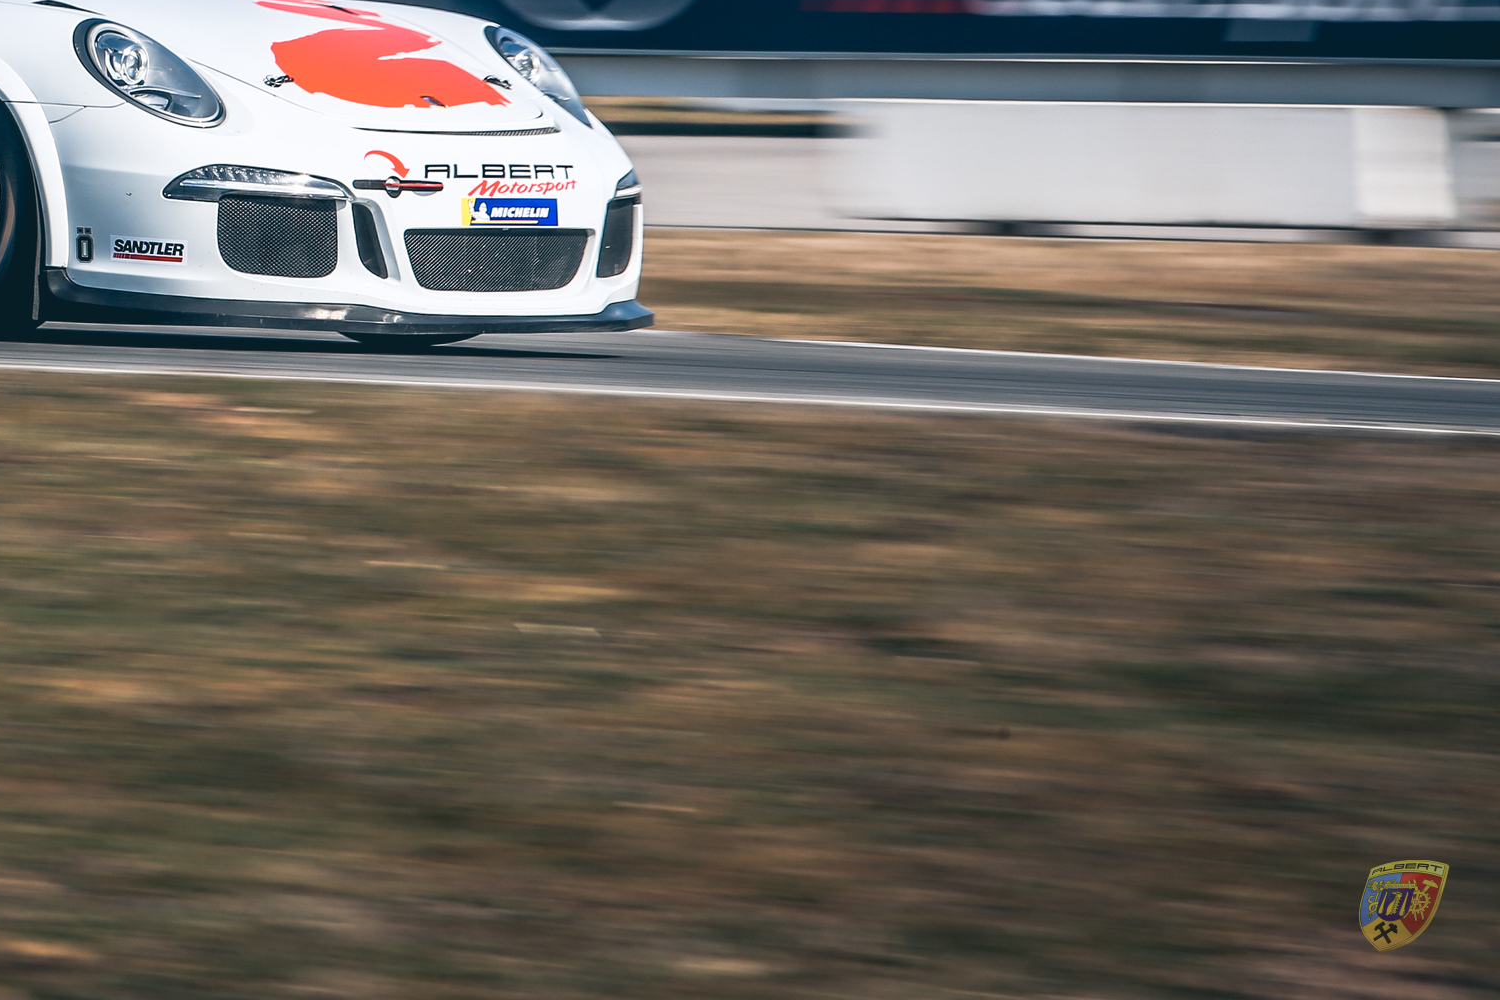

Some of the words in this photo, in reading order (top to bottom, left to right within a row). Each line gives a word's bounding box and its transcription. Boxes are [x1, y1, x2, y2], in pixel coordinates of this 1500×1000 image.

[424, 164, 574, 180] ALBERT
[467, 179, 578, 198] Motorsport
[490, 206, 550, 219] MICHELIN
[113, 239, 185, 257] SANDTLER
